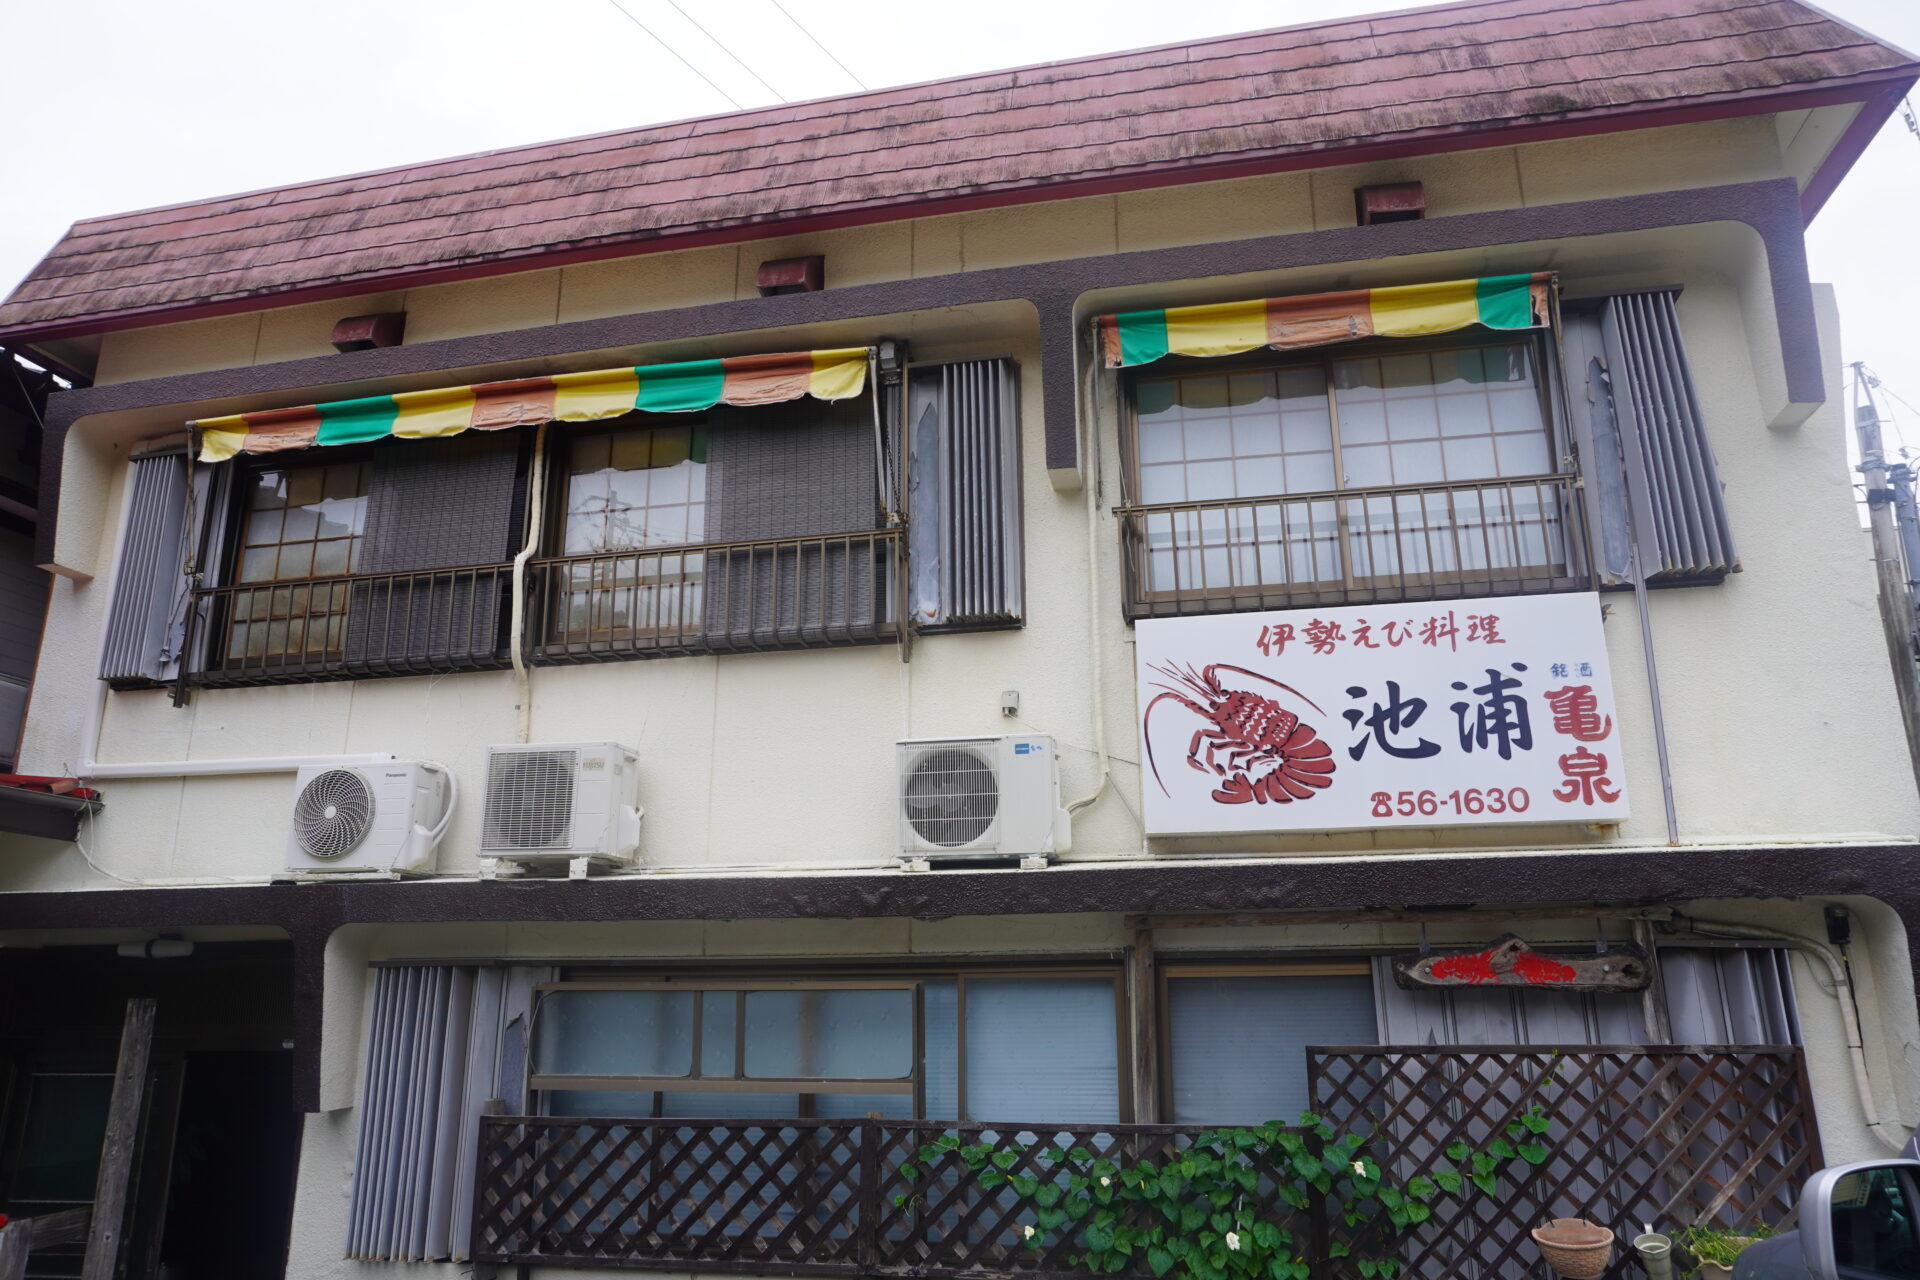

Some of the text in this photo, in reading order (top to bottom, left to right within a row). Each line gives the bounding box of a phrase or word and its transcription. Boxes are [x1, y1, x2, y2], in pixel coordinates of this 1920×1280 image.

[1256, 609, 1507, 657] 伊勢えび料理
[1550, 662, 1593, 679] 銘酒
[1342, 662, 1534, 762] 池浦
[1543, 684, 1622, 806] 亀泉
[1396, 786, 1530, 817] 56-1630
